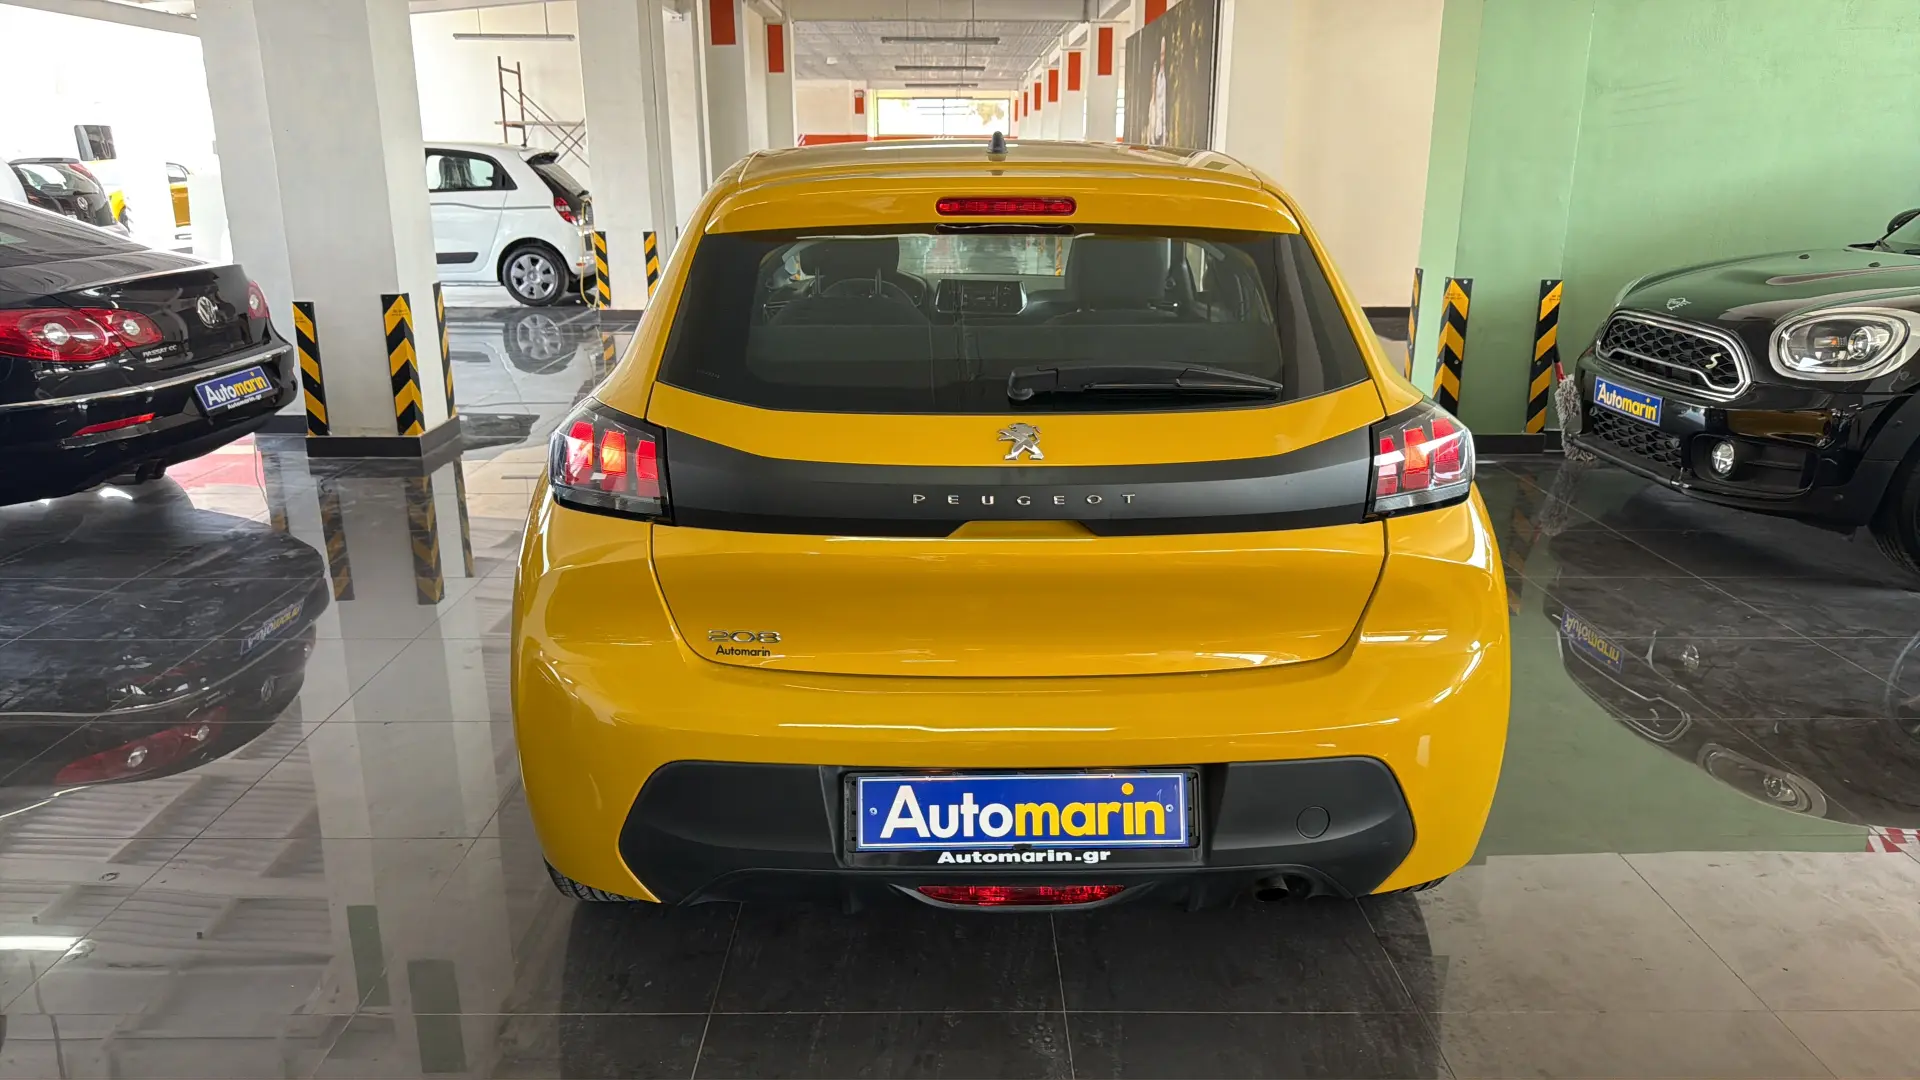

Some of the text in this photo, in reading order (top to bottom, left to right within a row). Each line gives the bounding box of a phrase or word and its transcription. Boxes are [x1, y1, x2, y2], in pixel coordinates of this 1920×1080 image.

[204, 371, 268, 406] Automarin
[1597, 382, 1656, 421] Automarin
[912, 493, 1136, 506] PEUGEOT
[708, 629, 782, 643] 208
[716, 644, 771, 657] Automarin
[880, 783, 1166, 839] Automarin
[936, 850, 1111, 864] Automarin.gr
